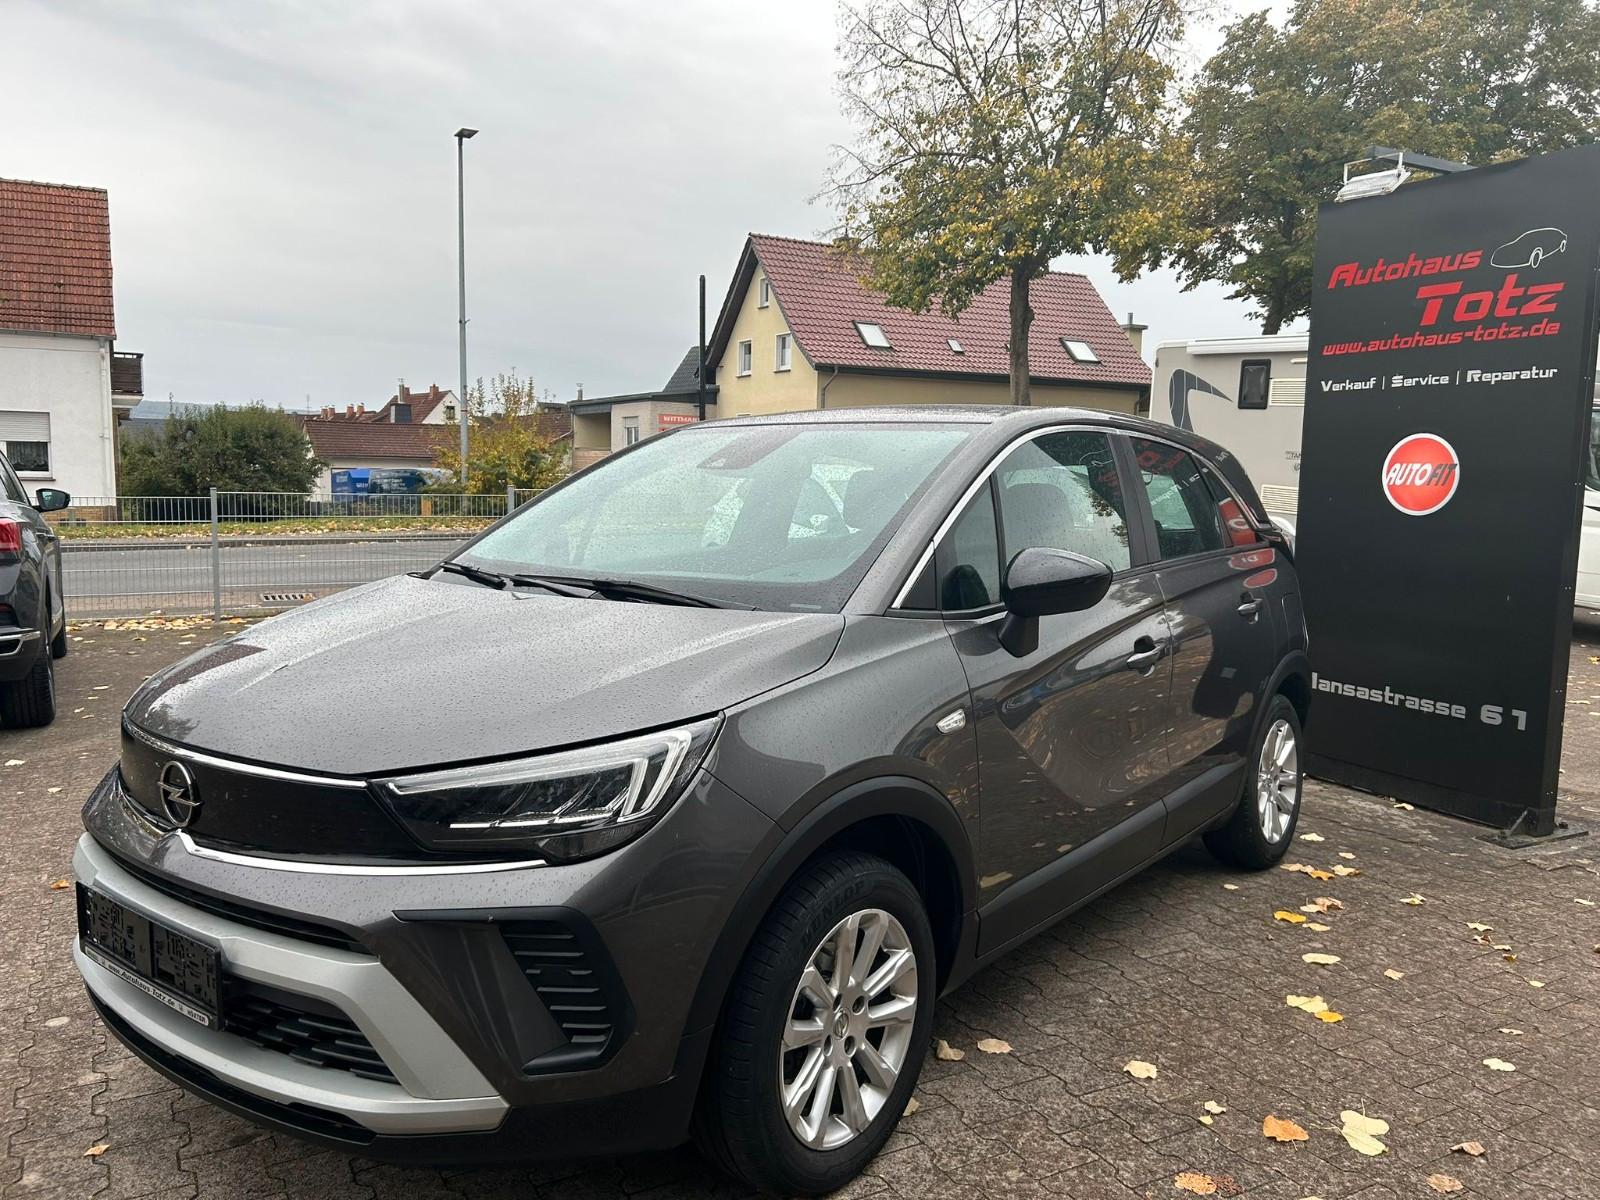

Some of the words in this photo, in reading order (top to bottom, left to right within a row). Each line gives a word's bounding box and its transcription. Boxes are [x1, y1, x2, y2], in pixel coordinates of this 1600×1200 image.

[1328, 249, 1483, 289] Autohaus
[1416, 273, 1566, 326] Totz
[1322, 318, 1560, 356] www.autohaus-totz.de
[1321, 377, 1377, 392] Verkauf
[1391, 374, 1449, 388] Service
[1466, 366, 1558, 384] Reparatur
[1387, 463, 1458, 486] AUTOFIT
[1480, 704, 1528, 731] 61
